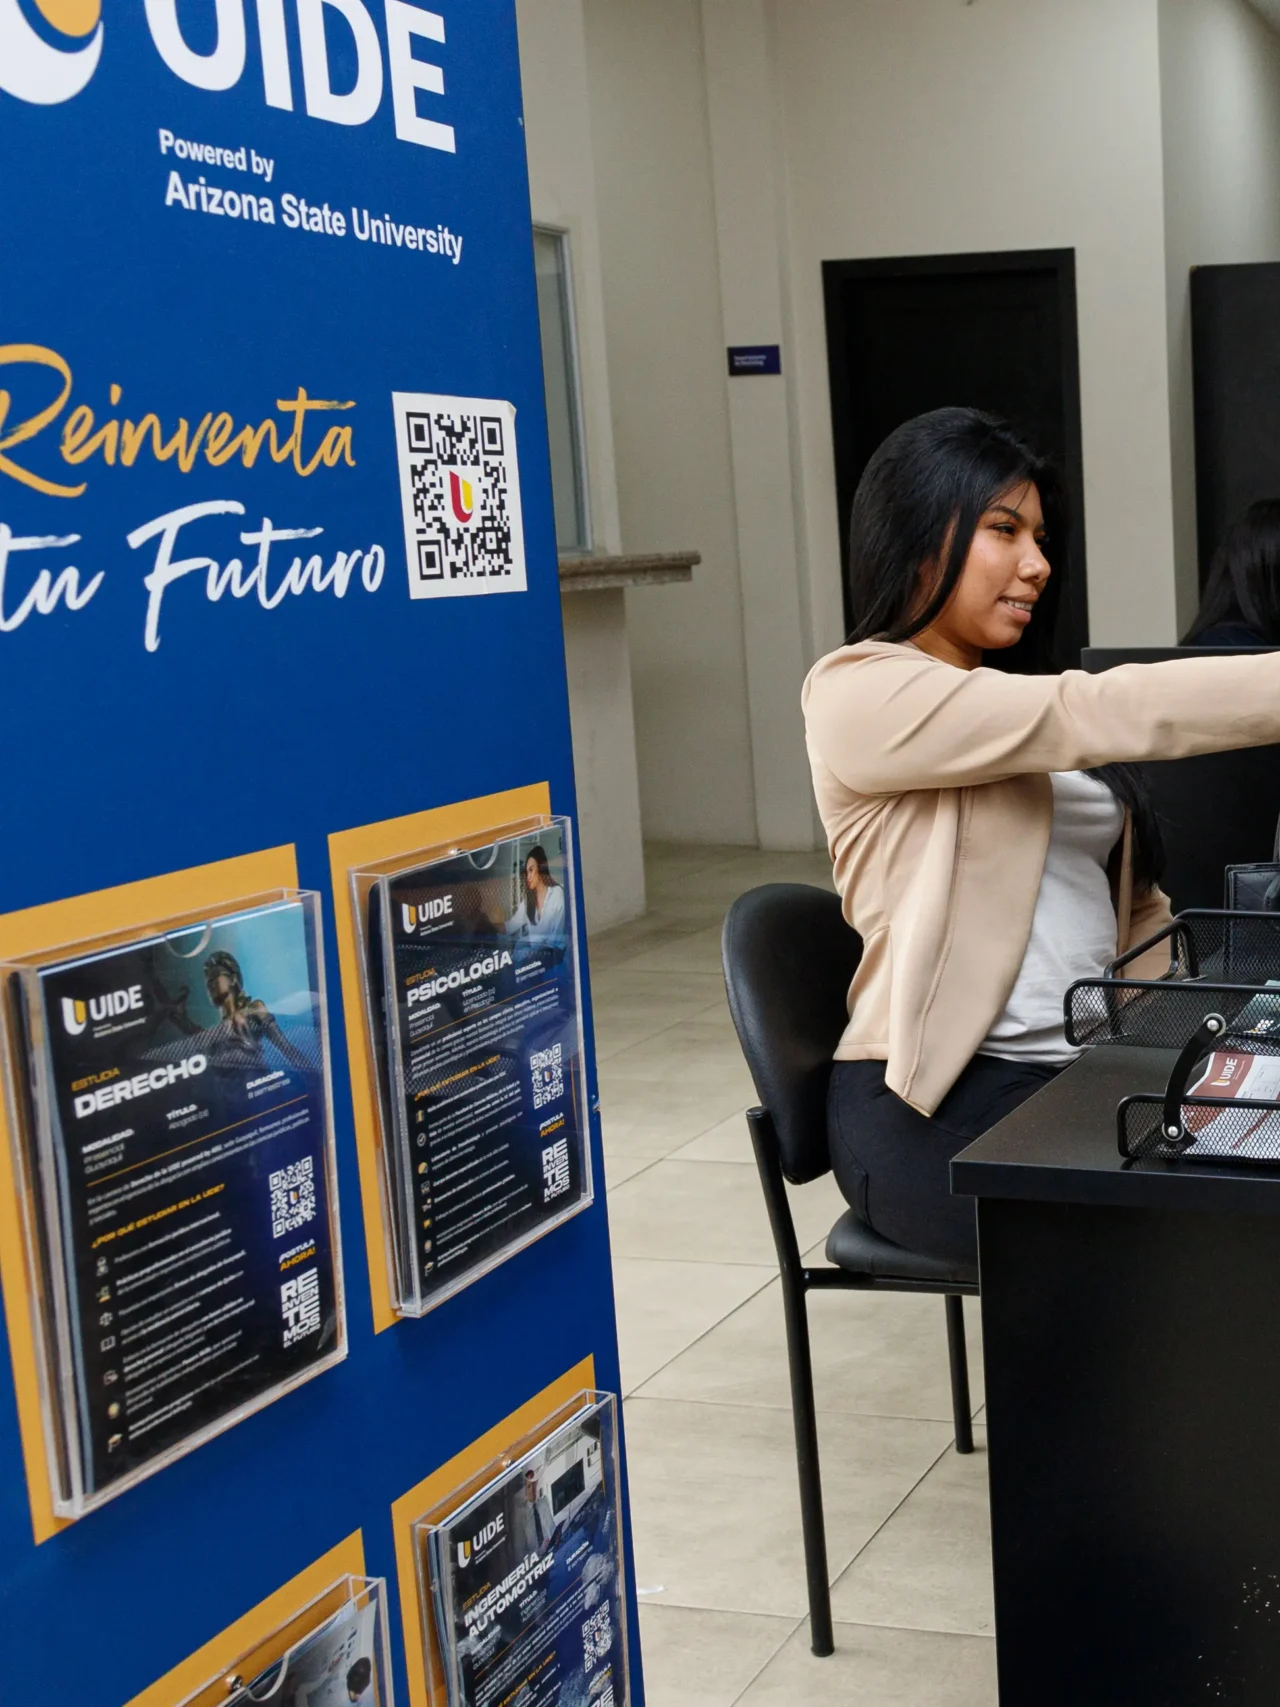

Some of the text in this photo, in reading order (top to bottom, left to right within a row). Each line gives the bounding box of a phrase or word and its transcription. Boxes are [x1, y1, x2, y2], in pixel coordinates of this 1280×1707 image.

[158, 128, 275, 182] Powered by
[164, 171, 464, 265] Arizona State University
[0, 343, 356, 499] Reinventa
[0, 500, 386, 653] tu Futuro
[418, 894, 453, 923] UIDE
[406, 949, 513, 1008] PSICOLOGÍA
[89, 984, 145, 1021] UIDE
[71, 1067, 121, 1092] ESTUDIA
[1220, 1057, 1238, 1075] UIDE
[73, 1053, 208, 1119] DERECHO
[541, 1138, 568, 1165] RE
[542, 1153, 569, 1172] INVEN
[543, 1161, 569, 1185] TE
[543, 1175, 570, 1196] MOS
[279, 1247, 317, 1272] AHORA!
[280, 1267, 318, 1302] RE
[282, 1289, 320, 1311] INVEN
[283, 1299, 320, 1328] TE
[283, 1317, 321, 1344] MOS
[472, 1512, 506, 1551] UIDE
[462, 1582, 492, 1610] ESTUDIA
[463, 1551, 540, 1628] INGENIERÍA
[468, 1551, 555, 1639] AUTOMOTRIZ
